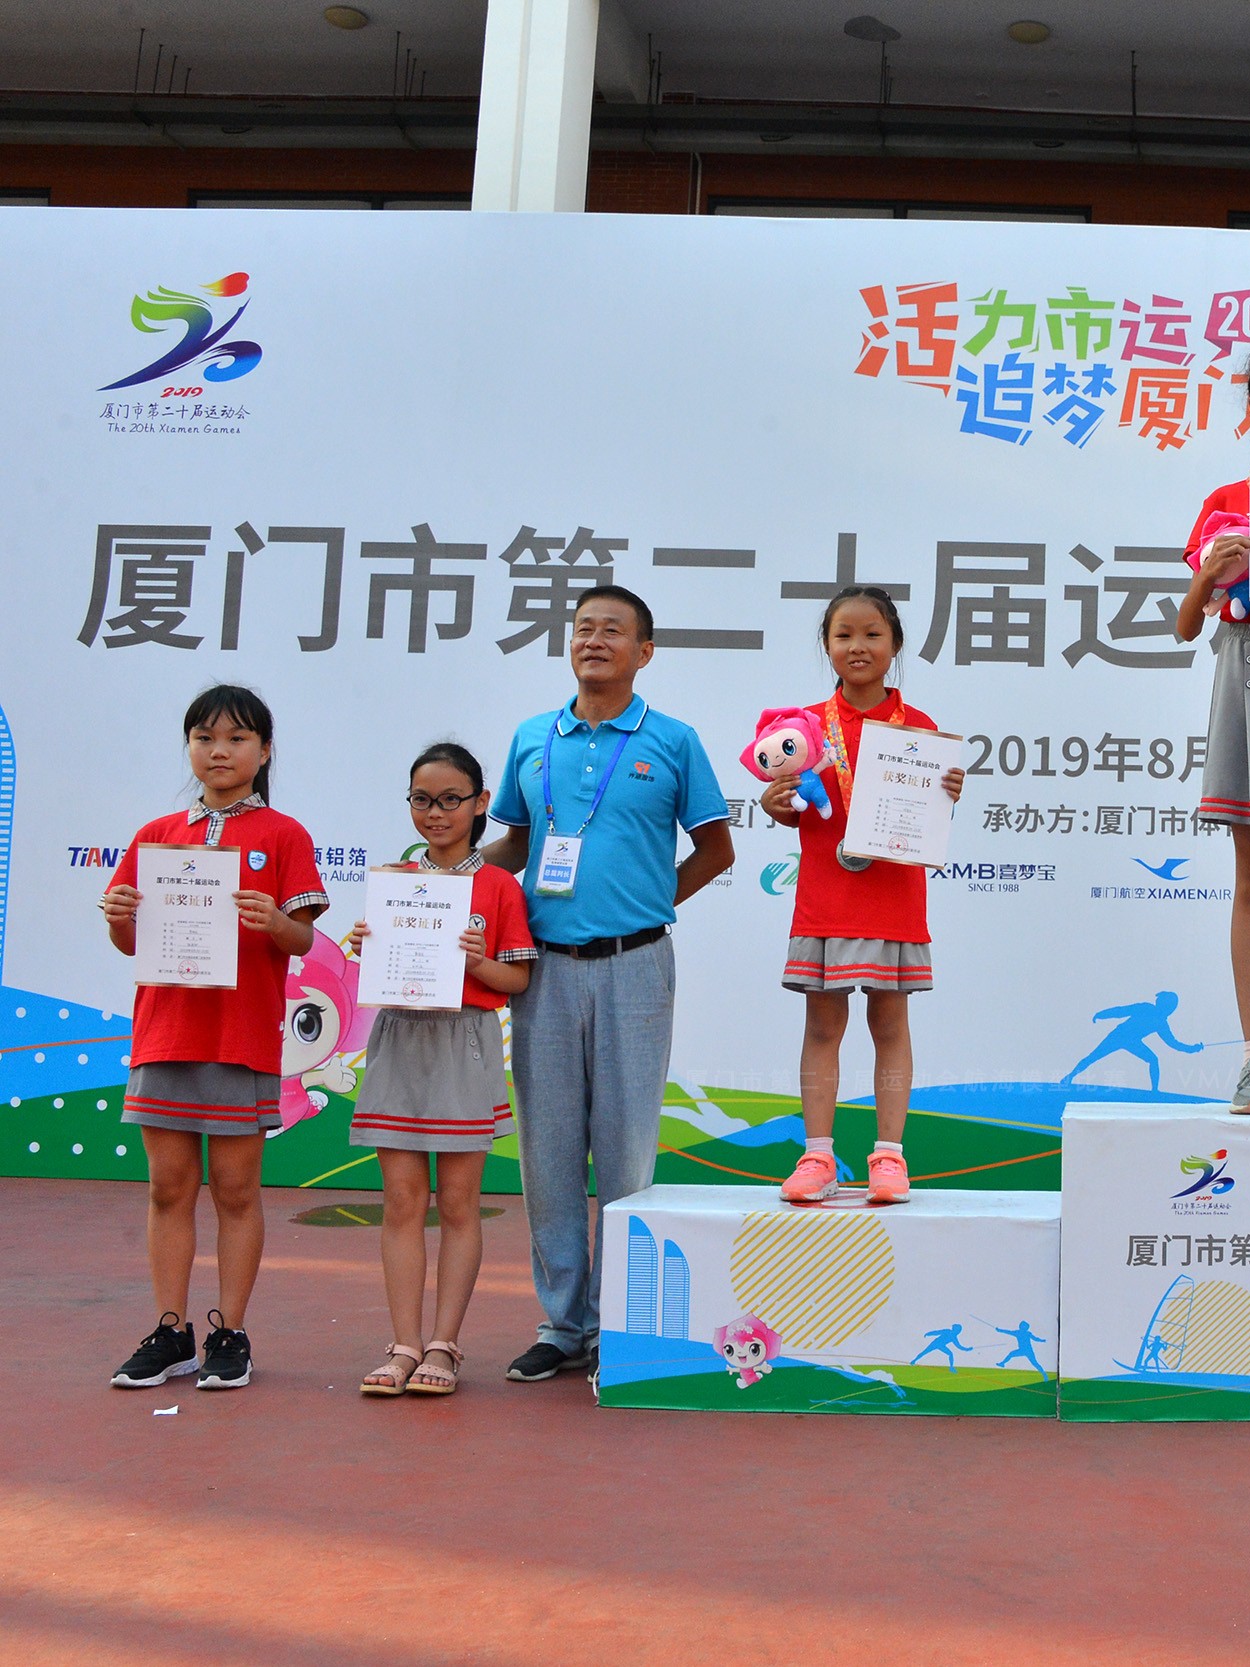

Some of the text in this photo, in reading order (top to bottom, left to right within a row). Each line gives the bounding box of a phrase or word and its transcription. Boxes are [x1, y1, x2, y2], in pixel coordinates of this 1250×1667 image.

[854, 281, 1195, 390] 活力市运
[160, 387, 204, 398] 2019
[100, 402, 251, 420] 厦门市第二十届运动会
[108, 423, 126, 433] The
[130, 423, 155, 433] 20th
[203, 424, 241, 434] Games
[877, 753, 941, 770] 厦门市第二十届运动会
[883, 770, 932, 788] 获奖证书
[330, 870, 365, 882] Alufoil
[999, 864, 1056, 881] 喜梦宝
[157, 876, 221, 887] 厦门市第二十届运动会
[968, 883, 1020, 893] SINCE 1988
[1090, 887, 1145, 899] 厦门航空
[163, 894, 213, 908] 获奖证书
[385, 899, 452, 910] 厦门市第二十届运动会
[392, 915, 443, 930] 获奖证书
